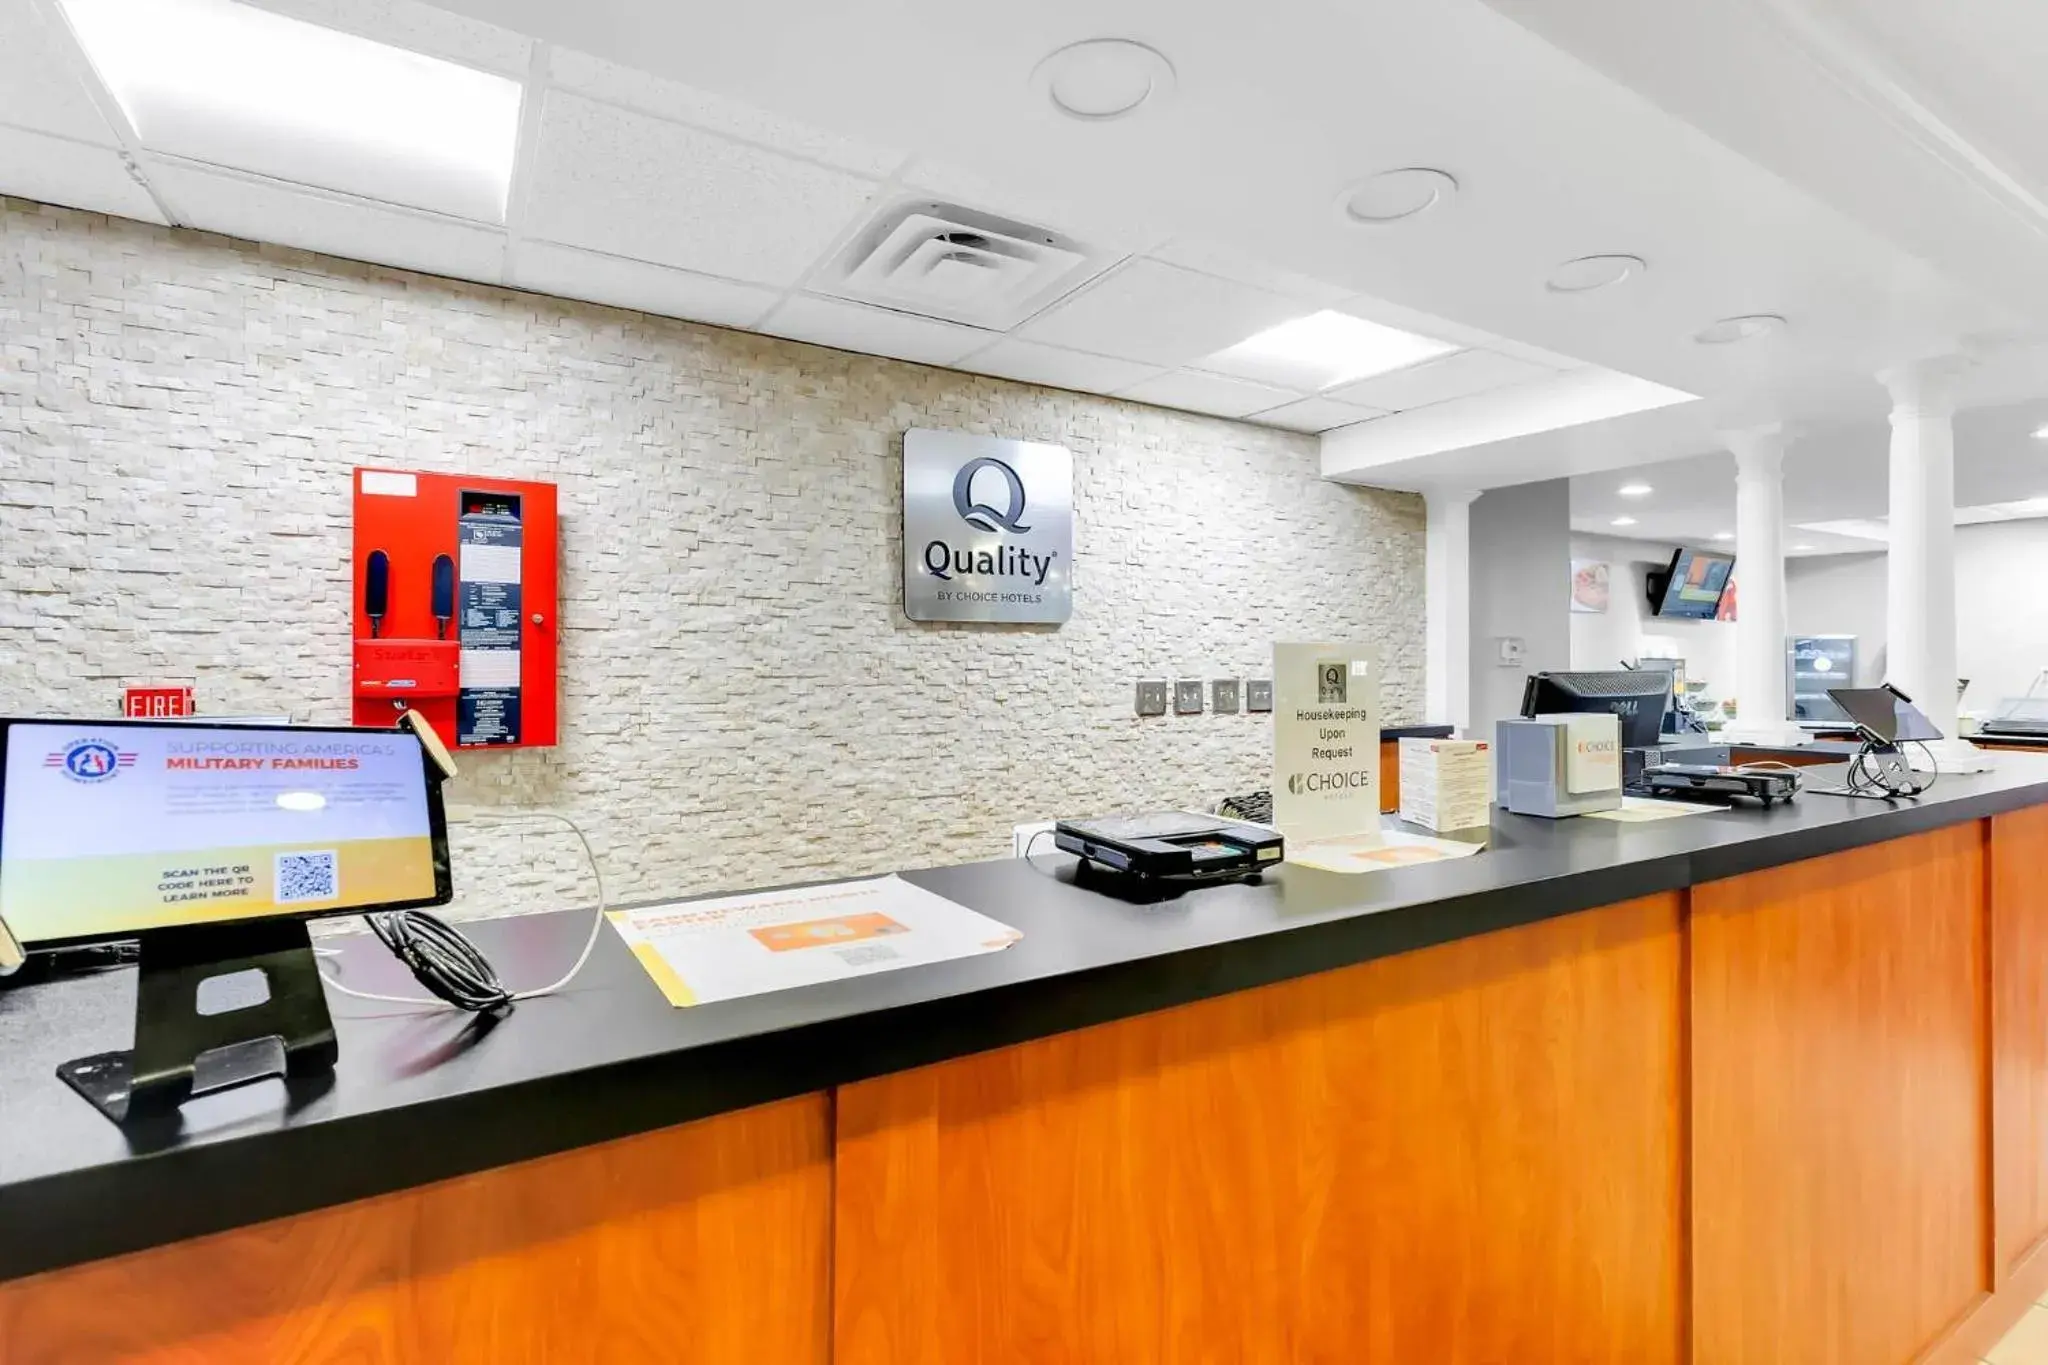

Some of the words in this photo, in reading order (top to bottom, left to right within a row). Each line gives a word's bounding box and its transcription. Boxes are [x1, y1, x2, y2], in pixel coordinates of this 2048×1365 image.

[952, 457, 1032, 534] Q
[937, 591, 953, 601] BY
[956, 592, 999, 602] CHOICE
[1001, 593, 1042, 603] HOTELS
[130, 695, 180, 717] FIRE
[1296, 708, 1367, 722] Housekeeping
[1319, 728, 1346, 741] Upon
[166, 741, 298, 755] SUPPORTING
[303, 744, 395, 756] AMERICA'S
[1311, 747, 1353, 760] Request
[166, 758, 265, 770] MILITARY
[271, 758, 360, 770] FAMILIES
[1306, 771, 1369, 791] CHOICE
[162, 869, 199, 879] SCAN
[203, 867, 228, 876] THE
[231, 865, 250, 873] QR
[157, 881, 194, 891] CODE
[199, 878, 233, 887] HERE
[238, 876, 254, 884] TO
[163, 892, 207, 903] LEARN
[212, 888, 249, 898] MORE
